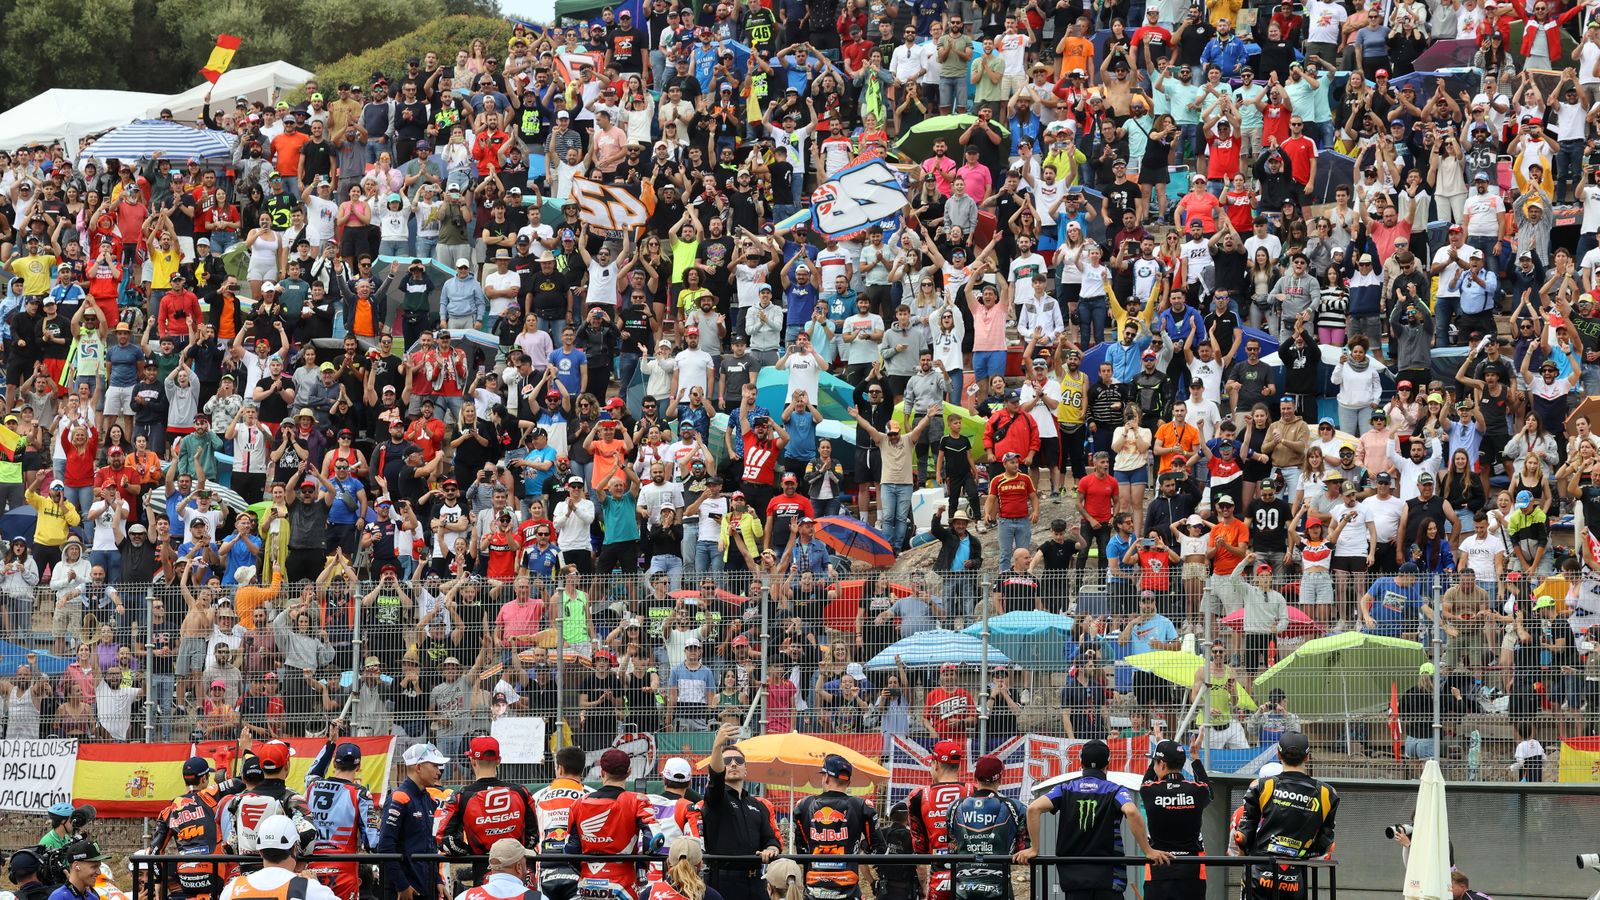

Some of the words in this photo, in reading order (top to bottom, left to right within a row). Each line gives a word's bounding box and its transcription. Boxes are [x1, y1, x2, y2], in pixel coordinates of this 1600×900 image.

[754, 26, 769, 39] 46
[1061, 389, 1082, 408] 46
[742, 466, 761, 479] 93
[1256, 508, 1279, 530] 90
[24, 739, 77, 758] PELOUSSE
[3, 762, 56, 781] PASILLO
[1154, 793, 1194, 808] aprilia
[1273, 788, 1313, 806] mooney
[475, 811, 520, 825] GASGAS
[963, 811, 996, 825] Wispr
[178, 825, 204, 840] KTM
[810, 827, 827, 841] Red
[827, 827, 849, 842] Bull
[813, 845, 845, 855] KTM
[967, 842, 993, 853] aprilia
